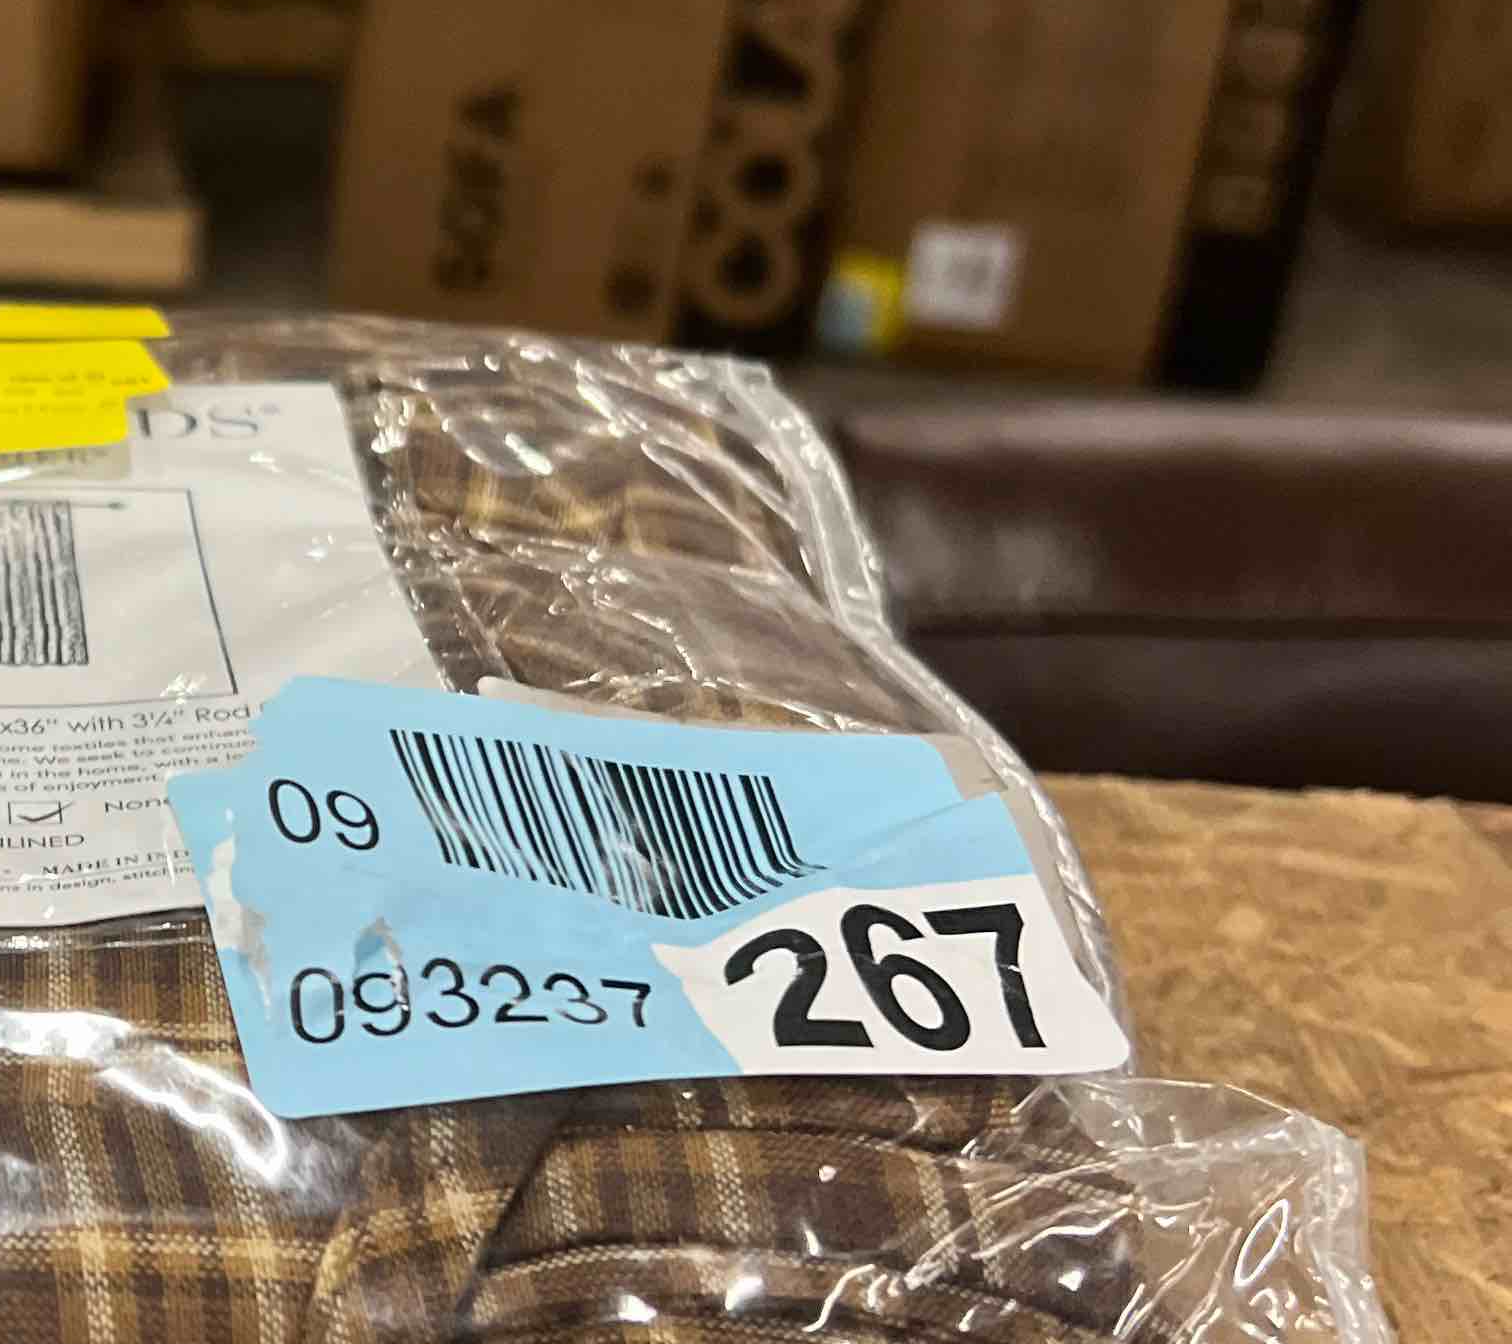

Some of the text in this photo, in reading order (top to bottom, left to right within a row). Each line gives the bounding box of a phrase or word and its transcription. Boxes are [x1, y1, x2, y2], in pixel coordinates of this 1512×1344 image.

[67, 715, 125, 733] with
[194, 705, 251, 724] Rod
[53, 738, 128, 753] textiles
[133, 735, 175, 746] that
[33, 755, 71, 766] We
[76, 752, 124, 764] seek
[133, 750, 155, 759] to
[10, 769, 29, 780] in
[36, 768, 71, 780] the
[154, 756, 199, 770] with
[13, 782, 37, 794] of
[267, 778, 382, 853] 09
[115, 853, 140, 867] IN
[27, 881, 44, 892] in
[290, 903, 1049, 1053] 093237 267
